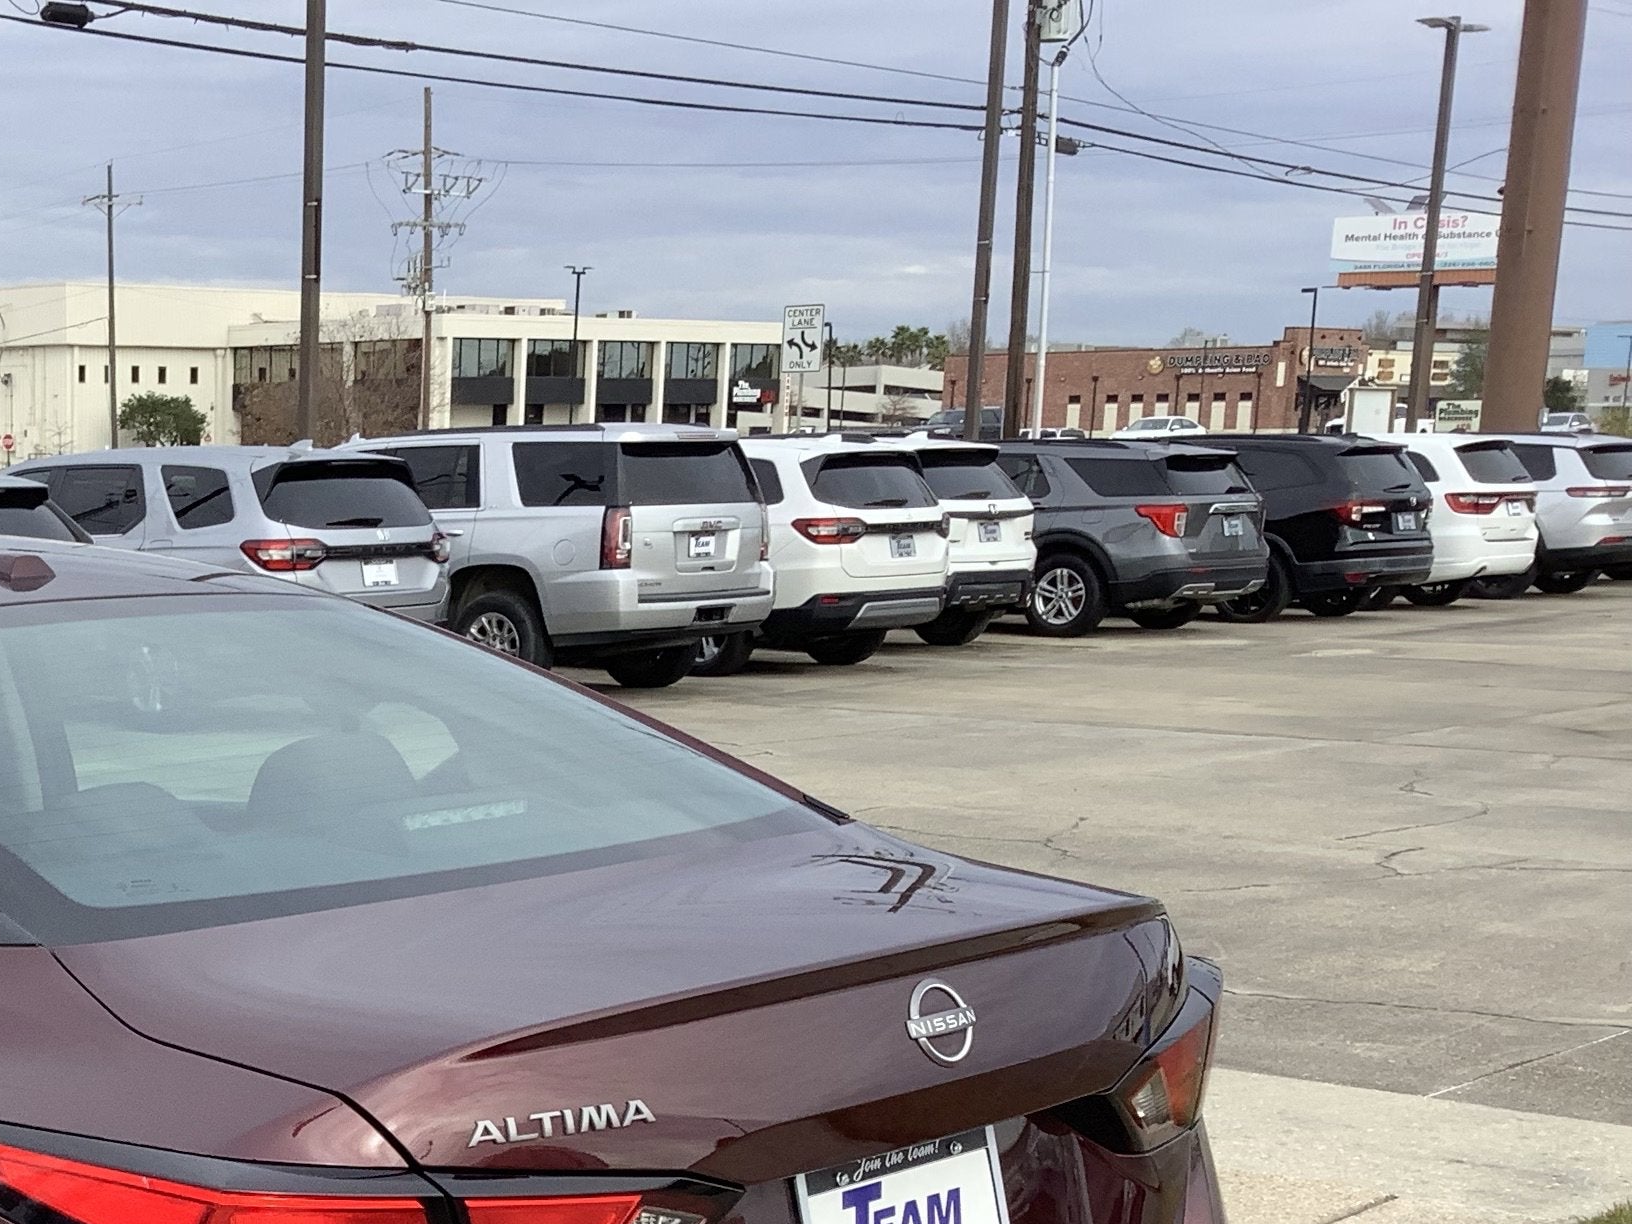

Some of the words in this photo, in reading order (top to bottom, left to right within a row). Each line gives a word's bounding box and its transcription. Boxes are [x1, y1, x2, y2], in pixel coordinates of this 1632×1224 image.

[1392, 218, 1408, 231] In
[1413, 215, 1469, 230] Csis?
[1344, 231, 1381, 243] Mental
[1384, 230, 1418, 241] Health
[1437, 229, 1492, 240] Substance
[787, 307, 821, 318] CENTER
[792, 317, 816, 327] LANE
[788, 360, 813, 369] ONLY
[1168, 354, 1230, 367] DUMPING
[1244, 353, 1271, 366] BAO
[1438, 408, 1479, 418] Plumbing
[694, 538, 711, 548] TEAM
[909, 1008, 977, 1037] NISSAN
[468, 1099, 657, 1148] ALTIMA
[853, 1154, 882, 1182] Join
[885, 1150, 904, 1168] the
[907, 1139, 940, 1162] team!
